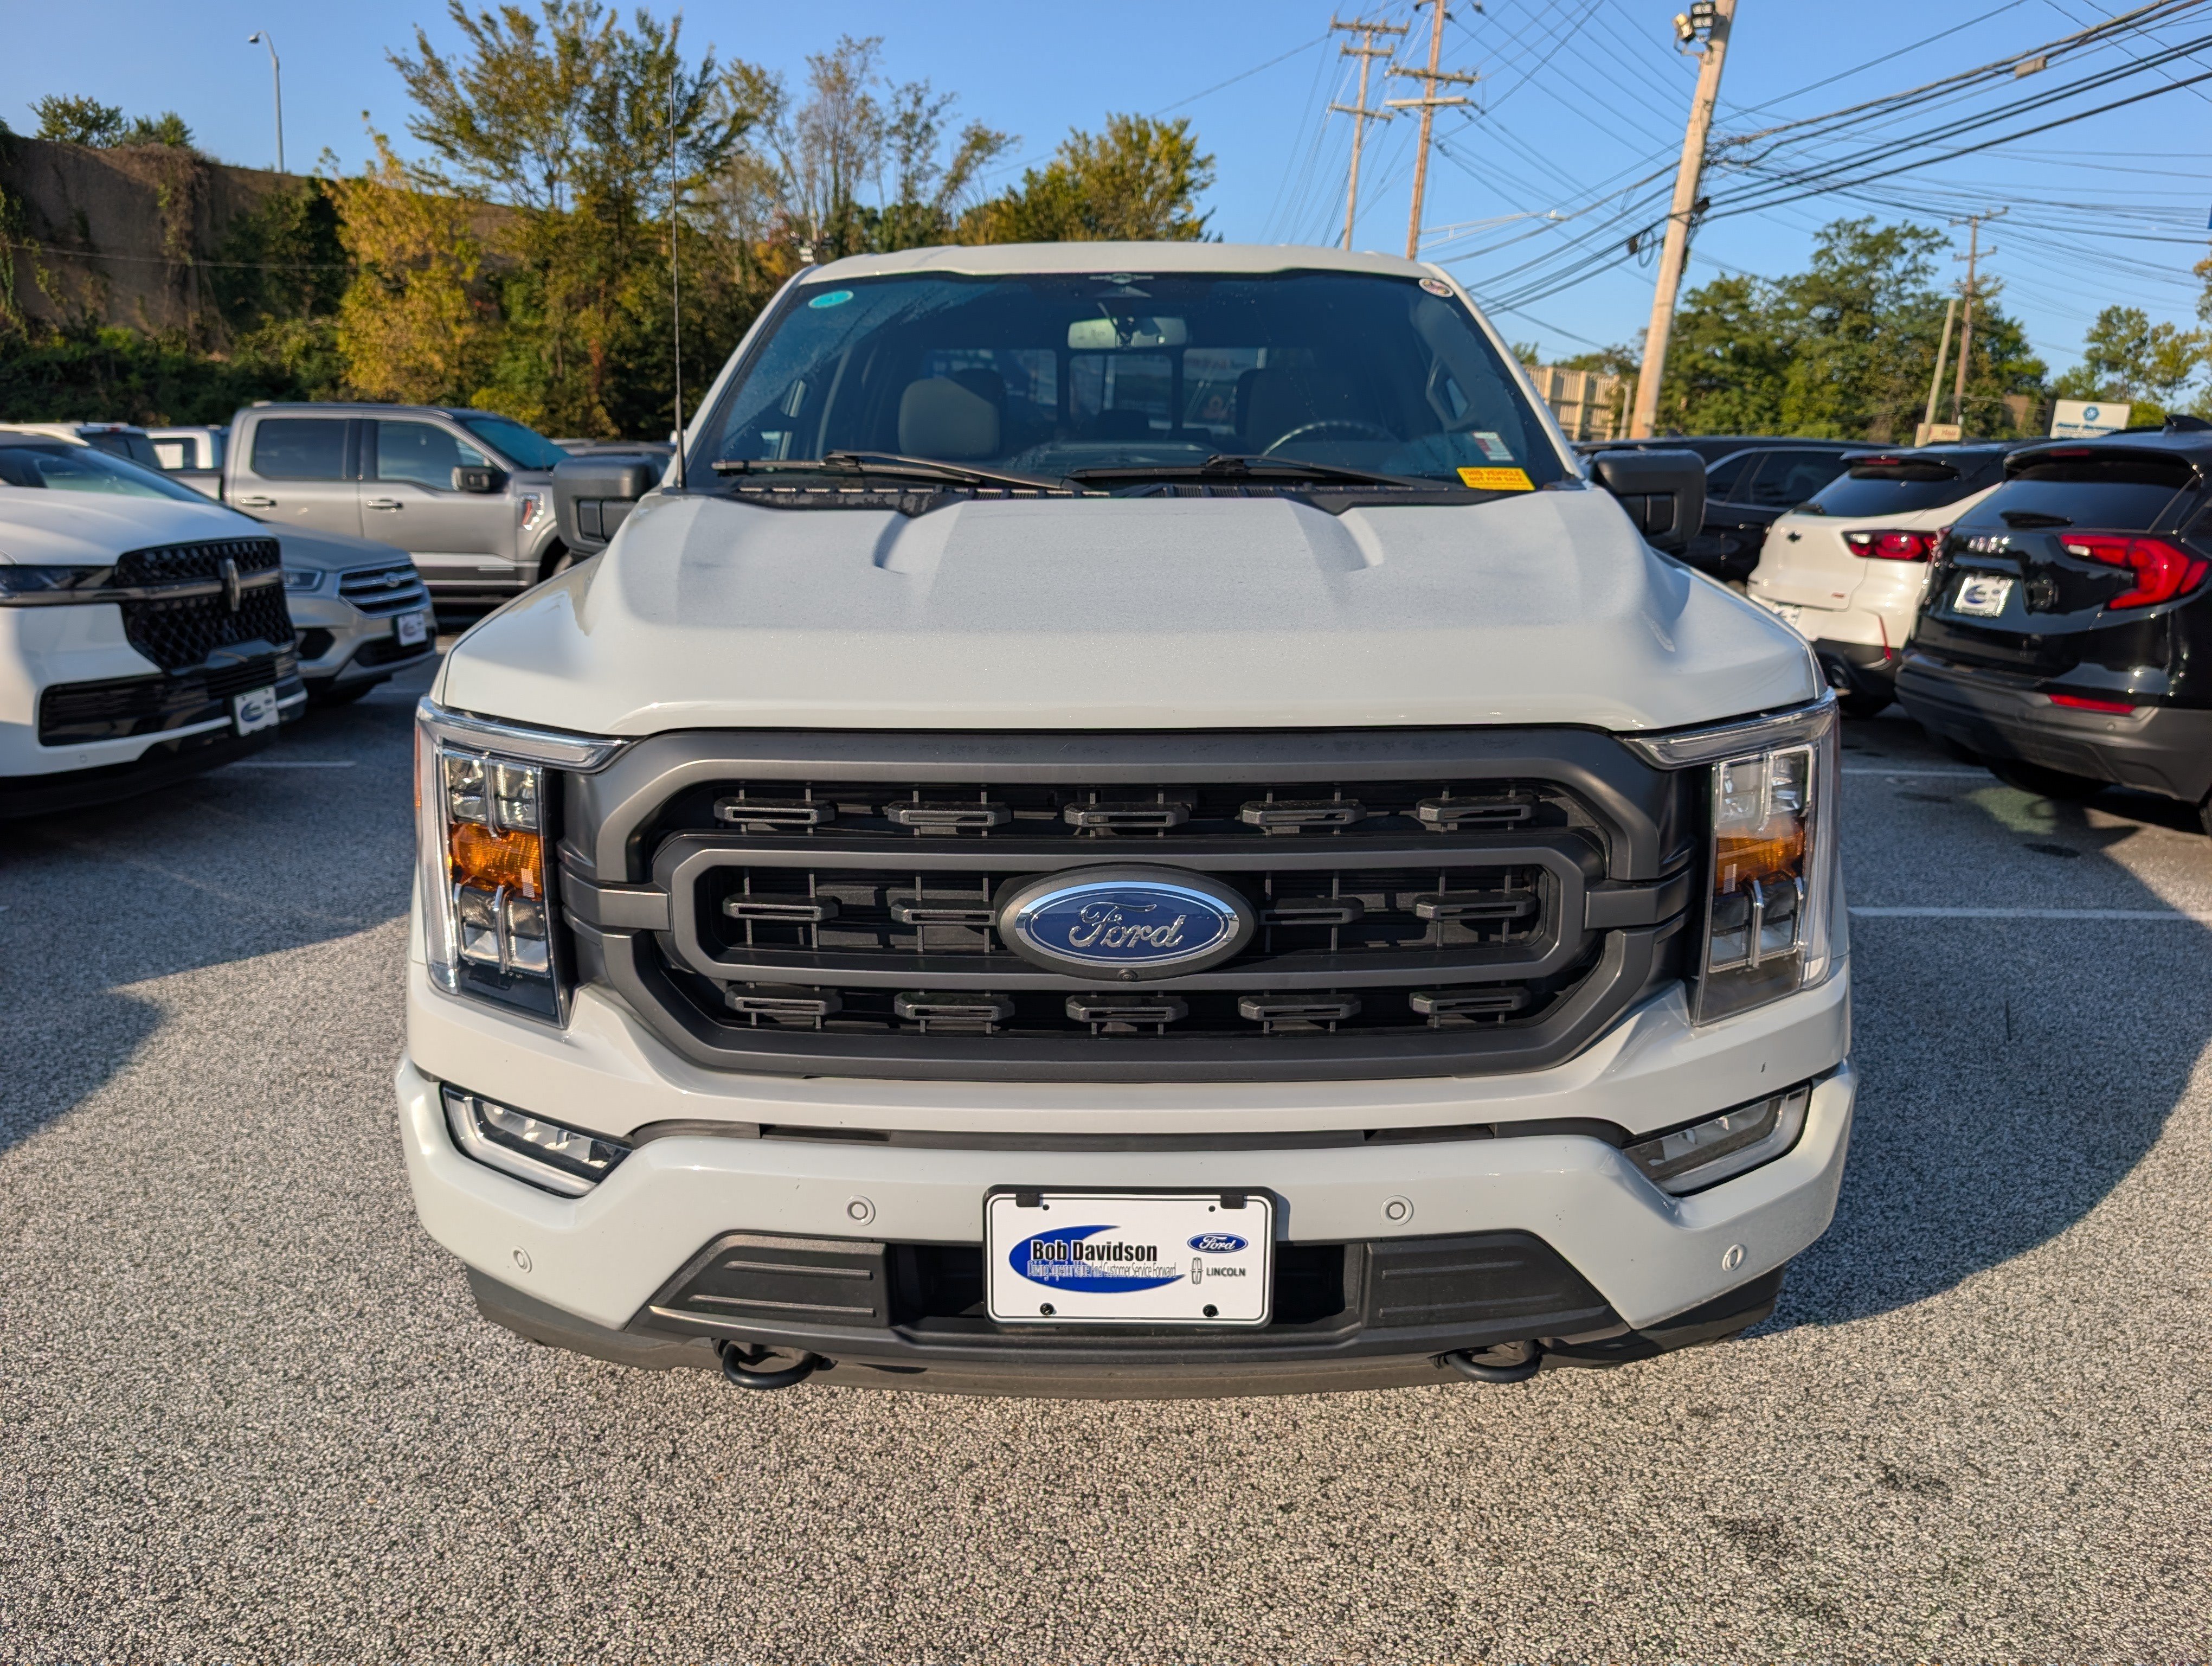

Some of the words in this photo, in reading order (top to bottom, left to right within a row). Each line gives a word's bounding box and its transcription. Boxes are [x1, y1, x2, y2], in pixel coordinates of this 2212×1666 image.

[1069, 901, 1187, 948] Ford
[1032, 1240, 1068, 1260] Bob
[1072, 1240, 1158, 1261] Davidson
[1199, 1235, 1237, 1250] Ford
[1103, 1261, 1131, 1277] Customer
[1131, 1261, 1152, 1277] Service
[1153, 1261, 1176, 1277] Forward
[1206, 1267, 1246, 1277] LINCOLN
